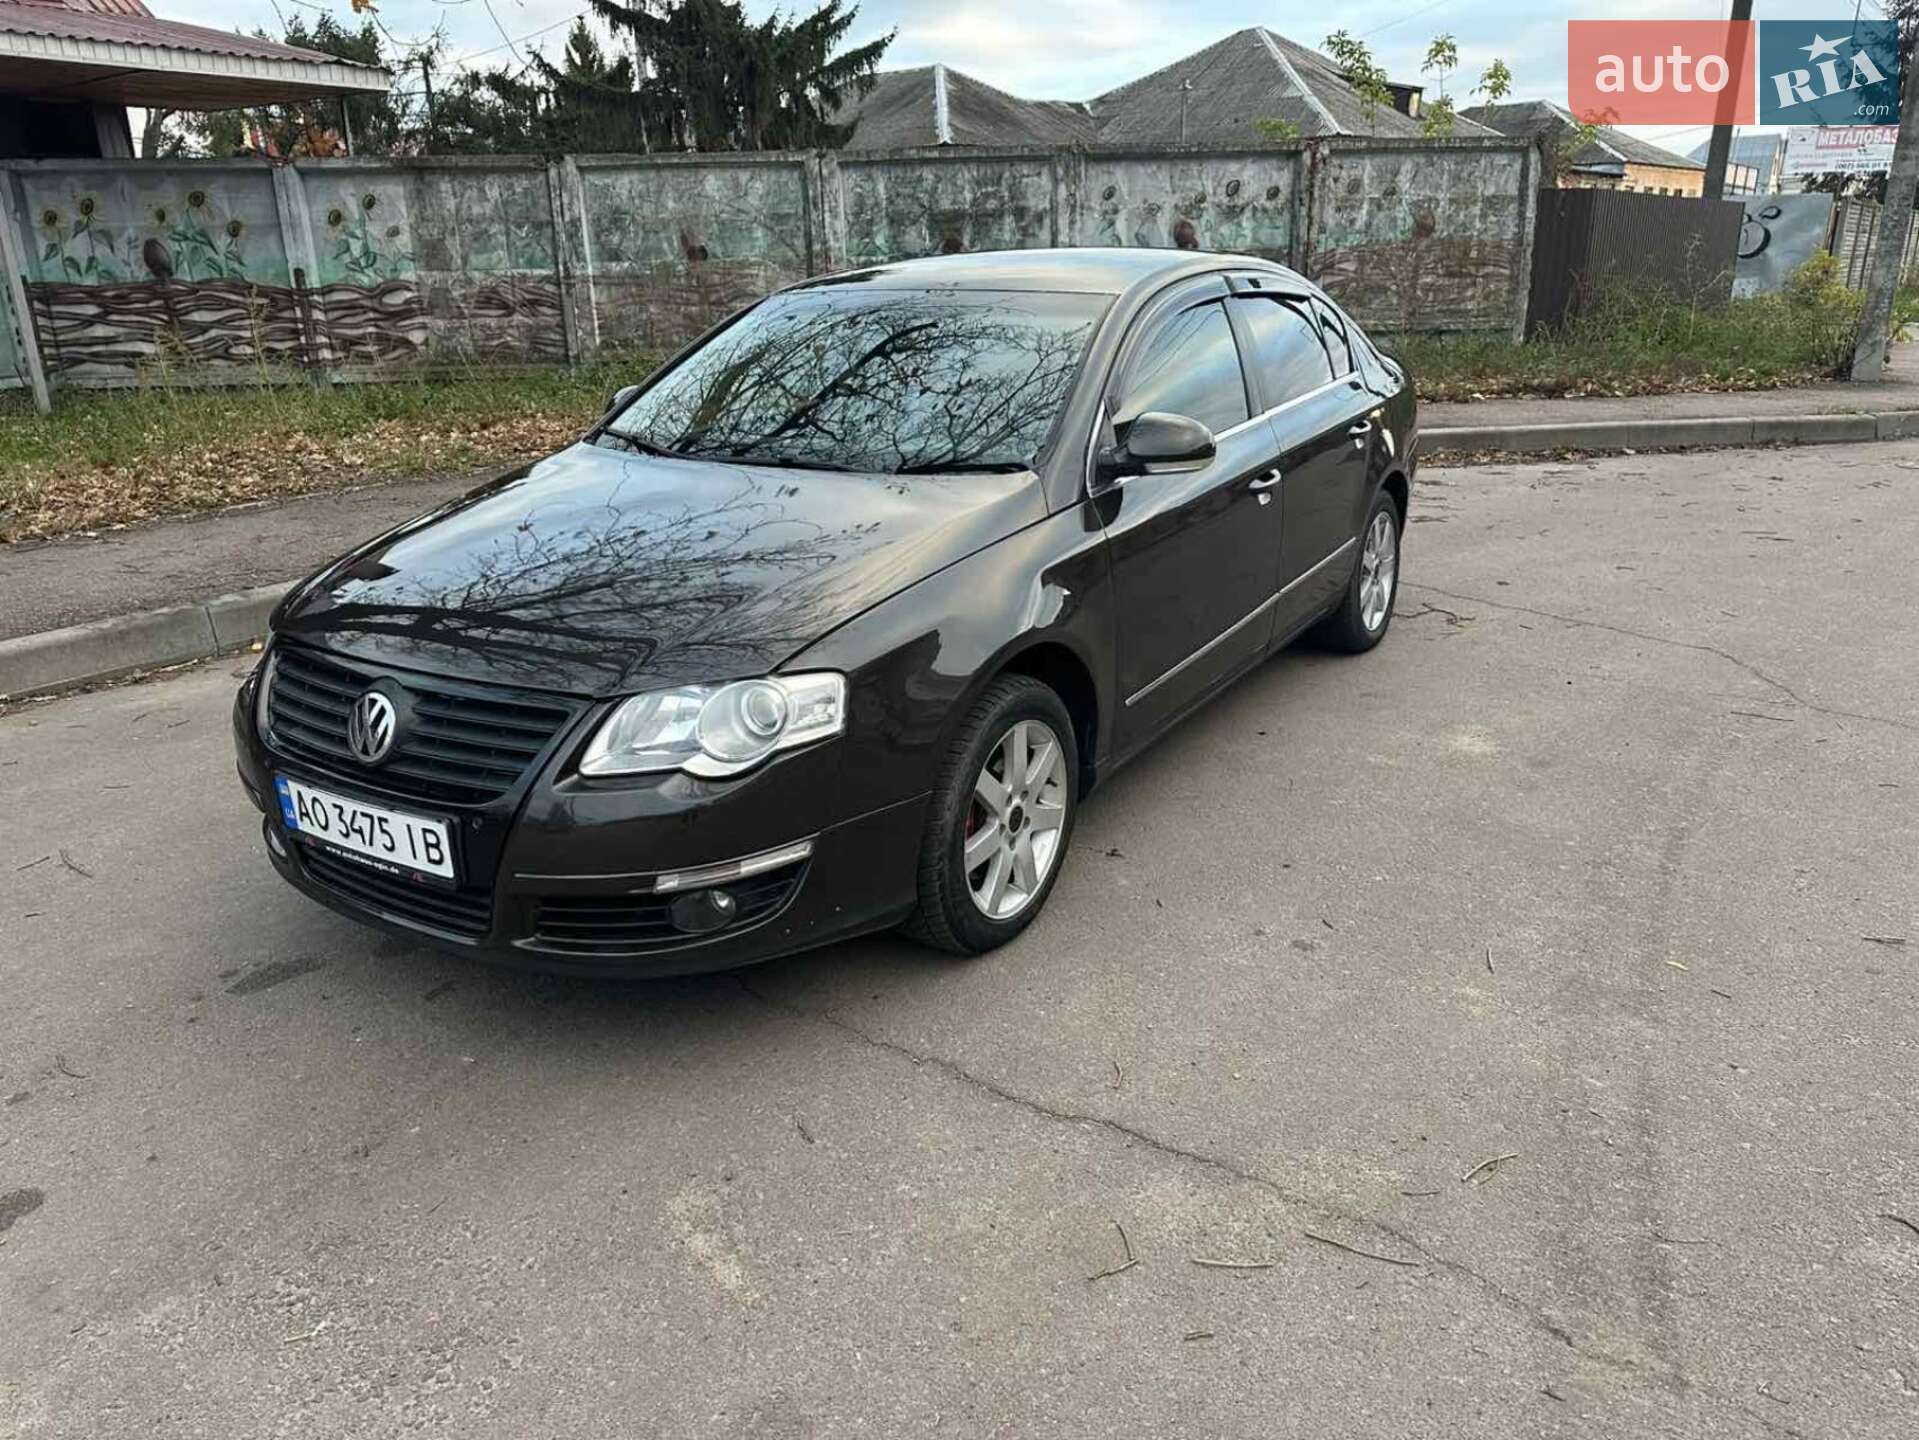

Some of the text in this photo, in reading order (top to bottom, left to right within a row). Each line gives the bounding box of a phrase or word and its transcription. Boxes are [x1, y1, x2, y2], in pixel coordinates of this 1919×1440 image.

[297, 789, 329, 832] AO
[332, 803, 396, 852] 3475
[406, 823, 444, 866] IB
